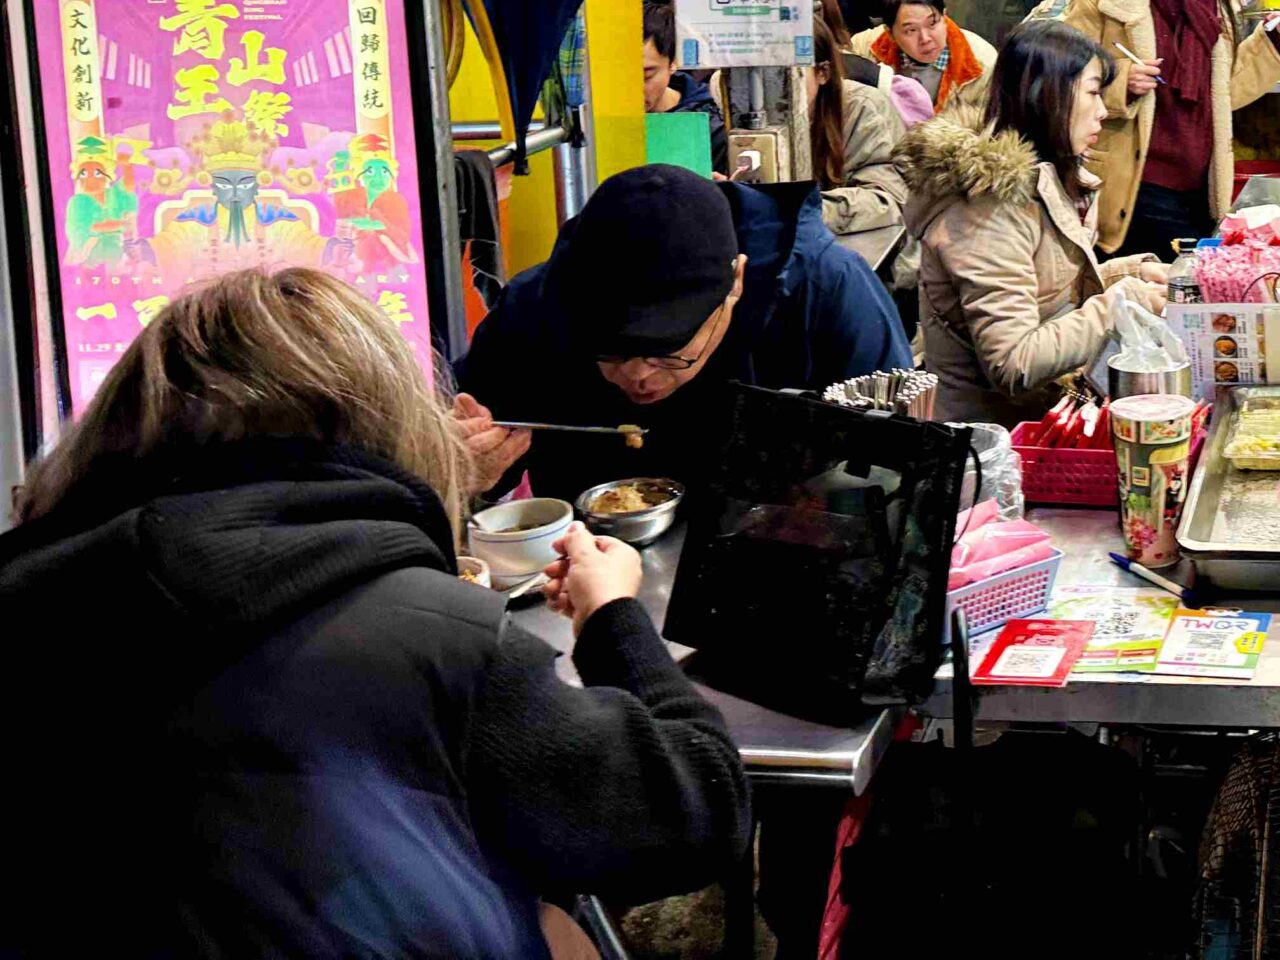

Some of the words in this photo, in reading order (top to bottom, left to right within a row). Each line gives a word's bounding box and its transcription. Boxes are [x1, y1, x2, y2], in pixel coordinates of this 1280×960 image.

[67, 8, 95, 111] 文化創新
[356, 5, 386, 110] 回歸傳統
